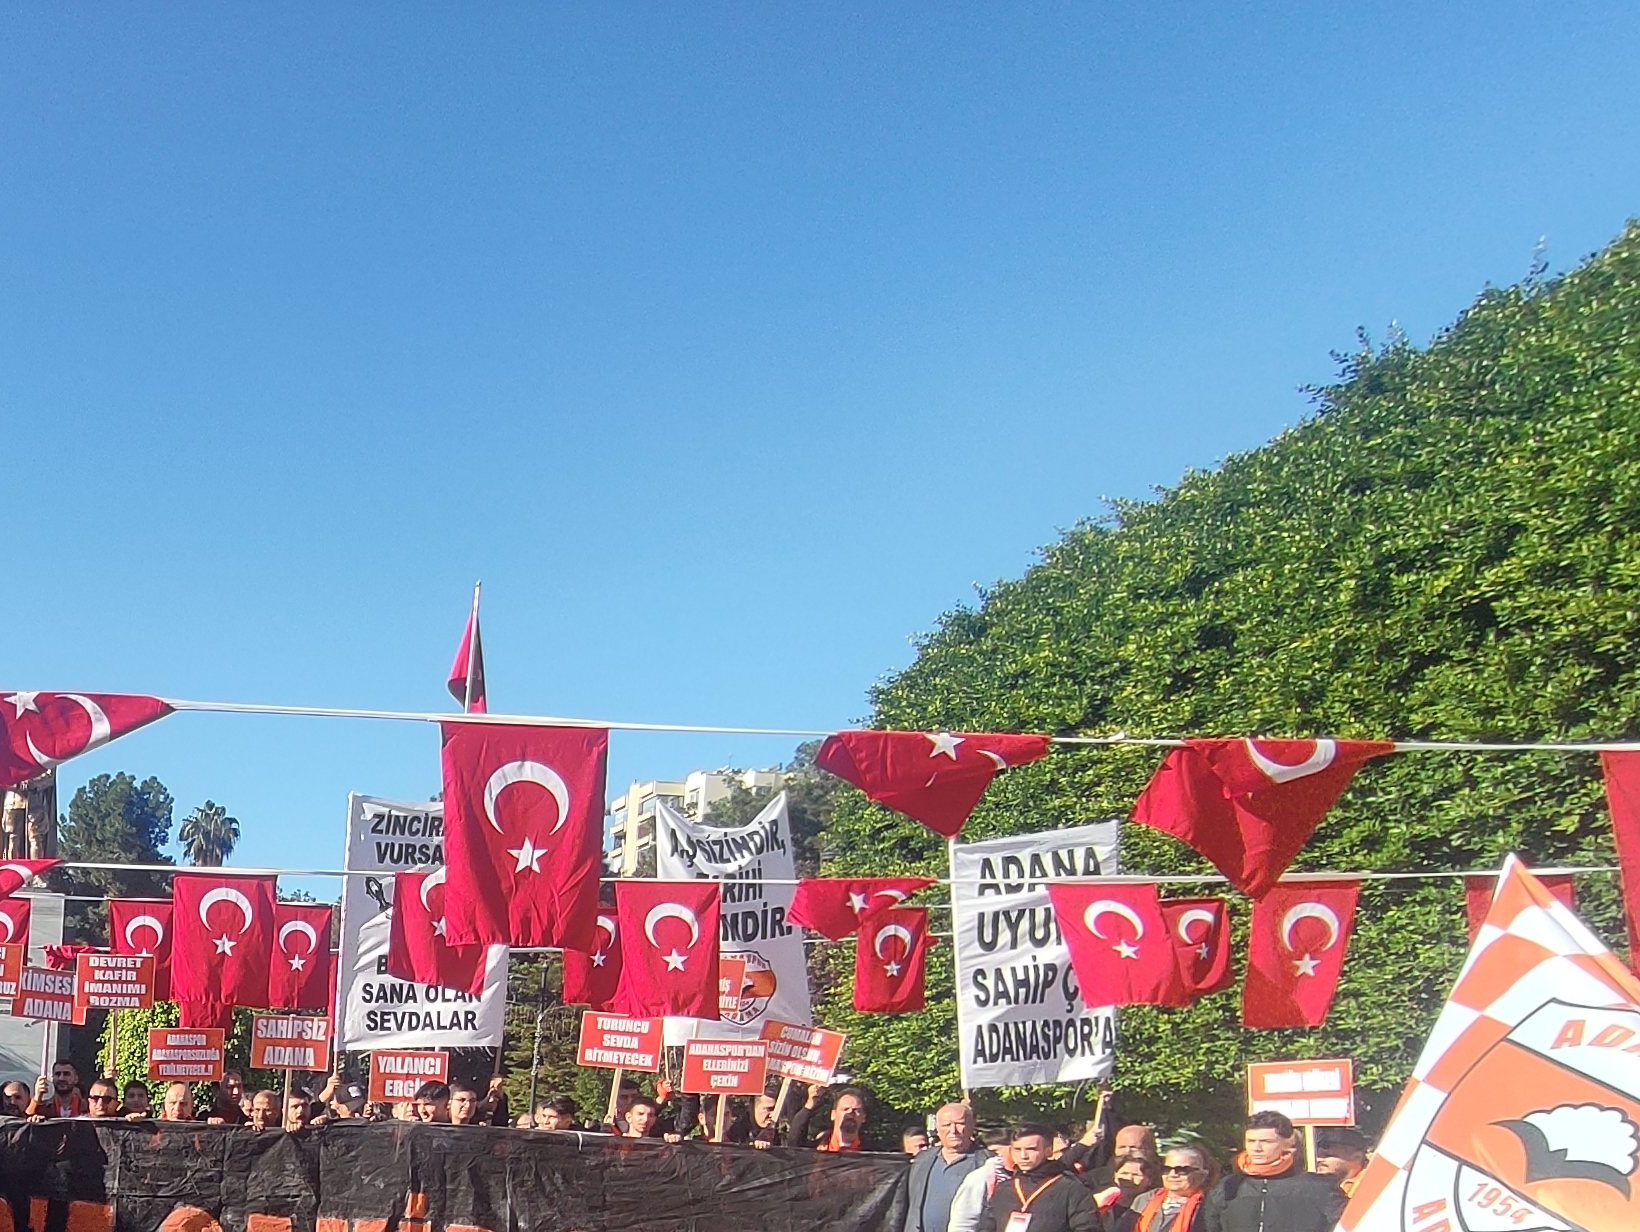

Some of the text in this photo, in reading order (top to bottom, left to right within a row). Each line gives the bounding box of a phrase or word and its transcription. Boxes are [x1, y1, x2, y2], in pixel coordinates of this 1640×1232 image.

[370, 810, 445, 838] ZİNCİR
[88, 957, 144, 968] DEVRET
[93, 969, 137, 982] KAFİR
[972, 955, 1059, 1008] SAHİP
[83, 982, 147, 995] İMANIMI
[361, 982, 418, 1005] SANA
[23, 997, 72, 1021] ADANA
[256, 1015, 327, 1041] SAHİPSİZ
[365, 1009, 478, 1032] SEVDALAR
[596, 1016, 650, 1034] TURUNCU
[602, 1033, 639, 1049] SEVDA
[688, 1043, 765, 1058] ADANASPOR'DAN
[972, 1016, 1114, 1065] ADANASPOR'A
[263, 1046, 315, 1067] ADANA
[378, 1055, 441, 1075] YALANCI
[584, 1047, 654, 1067] BİTMEYECEK
[702, 1058, 749, 1073] ELLERİNİZİ
[384, 1077, 426, 1098] ERGİ
[709, 1073, 739, 1088] ÇEKİN
[1467, 1182, 1535, 1225] 1954
